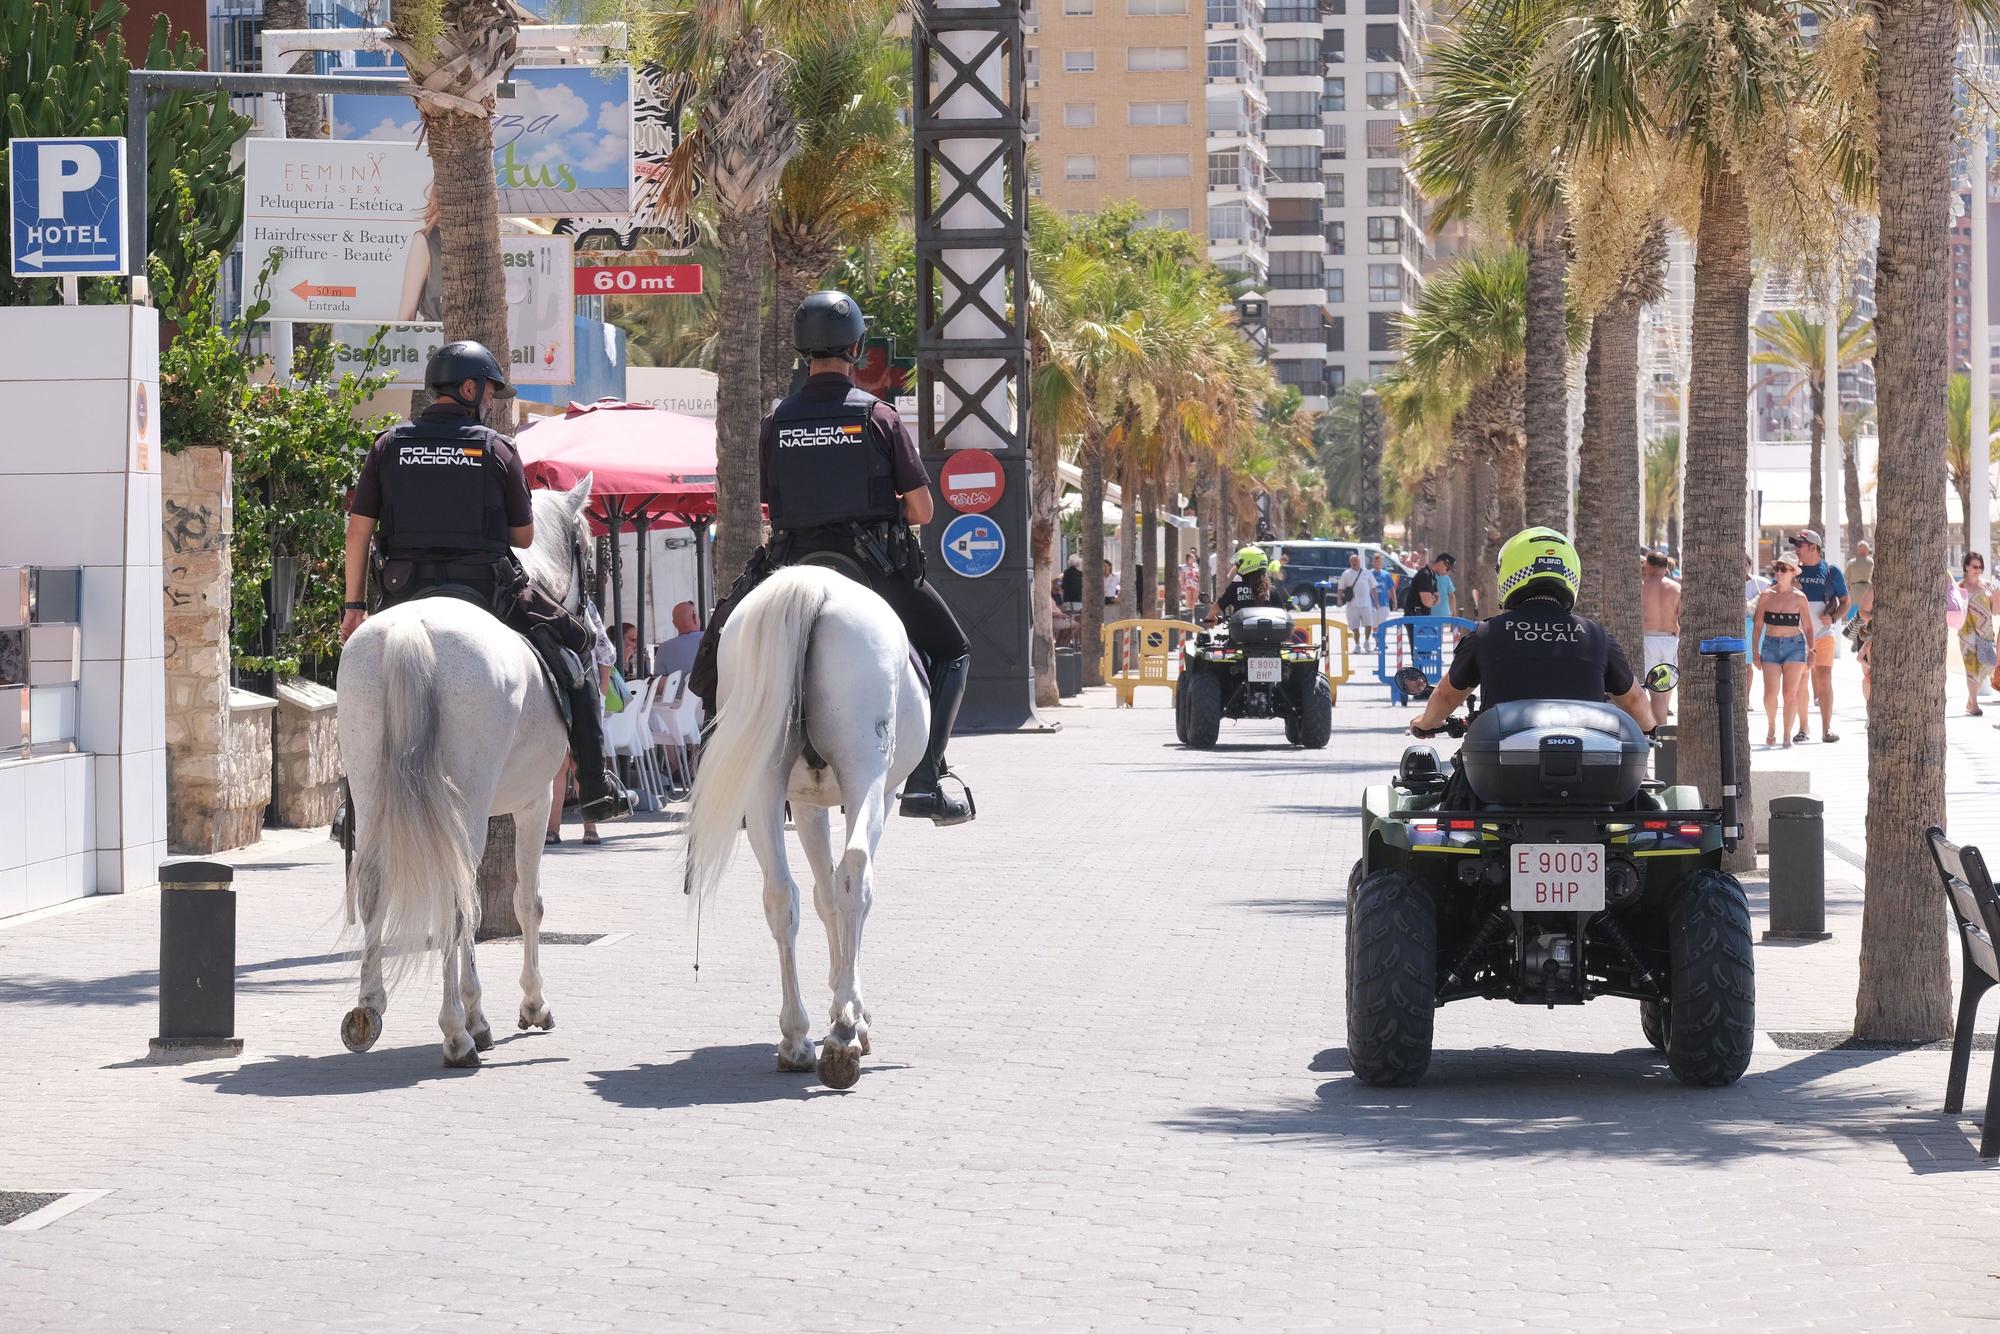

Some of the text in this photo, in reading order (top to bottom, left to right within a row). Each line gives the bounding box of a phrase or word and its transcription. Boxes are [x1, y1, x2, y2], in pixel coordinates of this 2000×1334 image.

[38, 144, 101, 219] P
[286, 183, 383, 195] UNISEX
[260, 194, 334, 213] Peluquería
[349, 197, 403, 212] Estética
[28, 225, 107, 244] HOTEL
[254, 226, 408, 249] Hairdresser & Beauty
[344, 247, 392, 262] Beauté
[316, 286, 342, 297] 50 m
[309, 300, 351, 312] Entrada
[779, 425, 844, 439] POLICIA
[779, 434, 862, 448] NACIONAL
[400, 446, 465, 456] POLICIA
[400, 455, 482, 467] NACIONAL
[1505, 621, 1586, 634] POLICIA
[1514, 630, 1579, 642] LOCAL
[1256, 671, 1273, 680] BHP
[1518, 852, 1599, 874] E 9003
[1535, 882, 1579, 903] BHP
